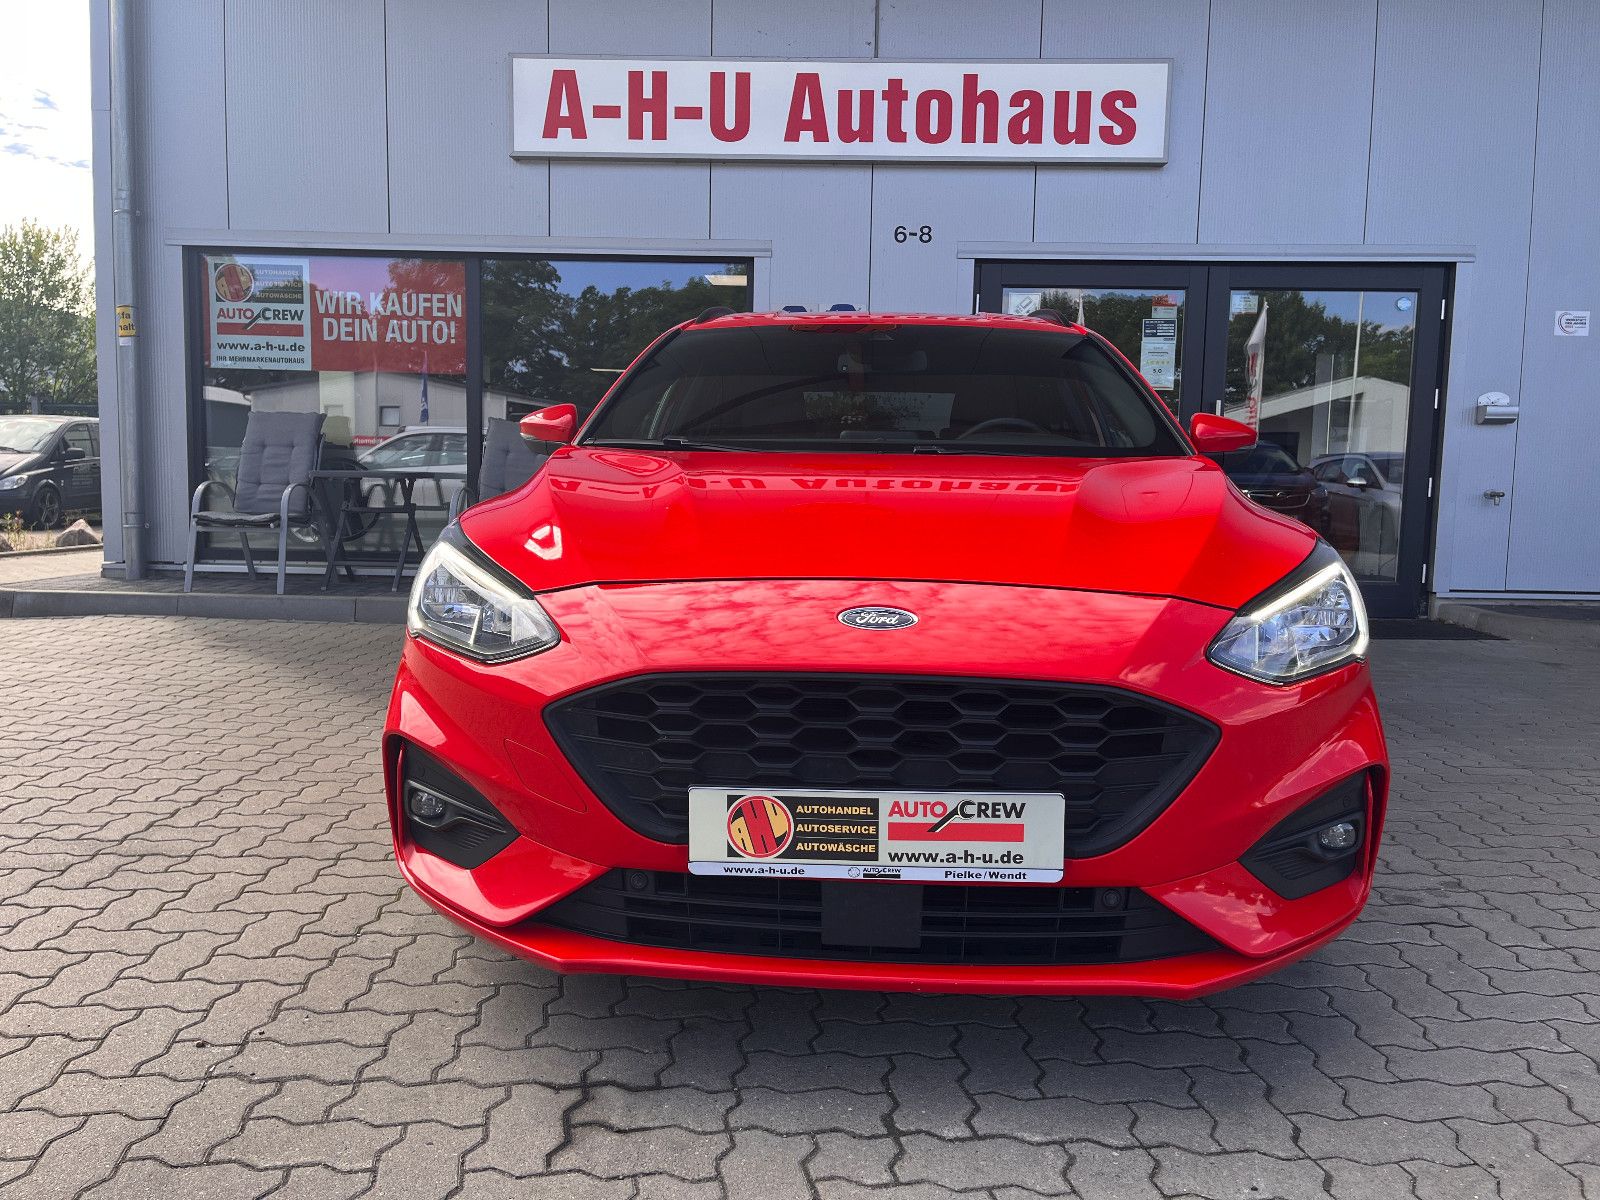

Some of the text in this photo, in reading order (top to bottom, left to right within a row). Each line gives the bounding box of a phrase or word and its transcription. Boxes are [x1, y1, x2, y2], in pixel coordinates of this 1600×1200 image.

[542, 69, 1138, 146] A-H-U Autohaus
[894, 225, 933, 244] 6-8
[315, 290, 463, 318] WIR KAUFEN
[217, 306, 305, 322] AUTO CREW
[322, 317, 457, 344] DEIN AUTO!
[217, 341, 306, 352] www.a-h-u.de
[228, 355, 305, 364] MEHRMARKENAUTOHAUS
[855, 611, 899, 624] Ford
[796, 805, 874, 816] AUTOHANDEL
[888, 800, 1026, 819] AUTO CREW
[796, 823, 877, 835] AUTOSERVICE
[796, 842, 876, 854] AUTOWÄSCHE
[887, 850, 1025, 865] www.a-h-u.de
[723, 866, 806, 876] www.a-h-u.de
[944, 870, 1027, 881] Pielke/Wendt
